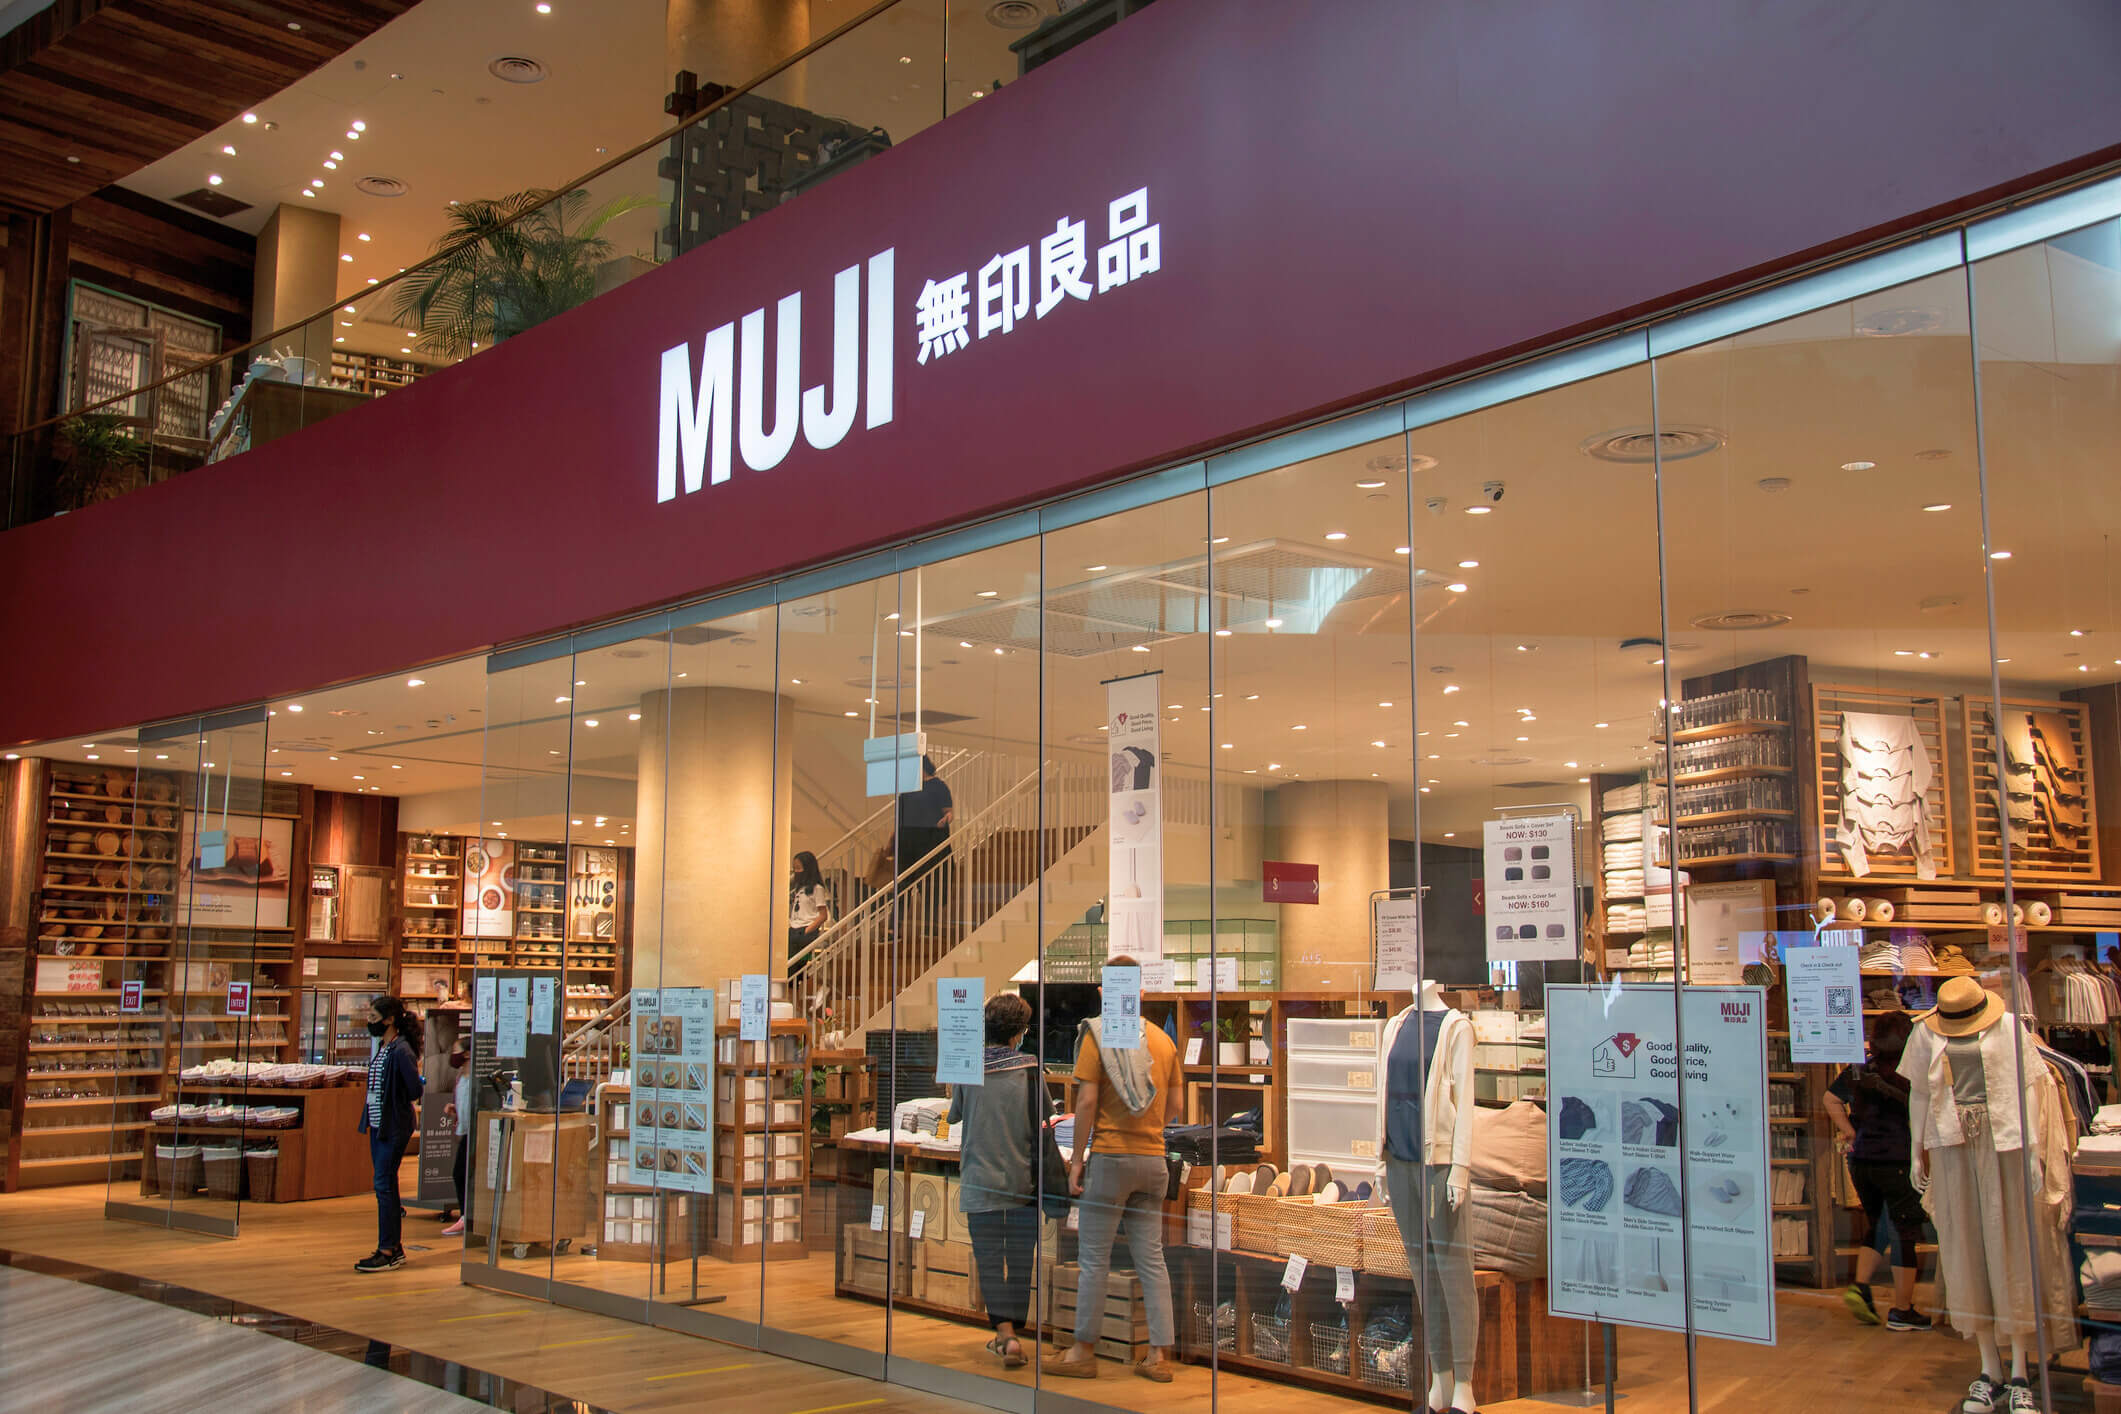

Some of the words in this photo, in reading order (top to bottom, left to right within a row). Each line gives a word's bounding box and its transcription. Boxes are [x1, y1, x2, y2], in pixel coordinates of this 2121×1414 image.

[916, 186, 1161, 366] 無印良品
[657, 246, 895, 504] MUJI
[1506, 831, 1527, 839] NOW:
[1529, 830, 1548, 838] $130
[953, 989, 967, 998] MUJI
[125, 996, 136, 1005] EXIT
[644, 998, 656, 1006] MUJI
[1720, 1003, 1750, 1016] MUJI
[1646, 1041, 1673, 1052] Good
[1683, 1043, 1712, 1054] uality,
[1650, 1055, 1677, 1065] Good
[1685, 1057, 1708, 1068] rice,
[1650, 1068, 1677, 1079] Good
[1685, 1070, 1708, 1082] iving
[440, 1116, 453, 1128] 3F
